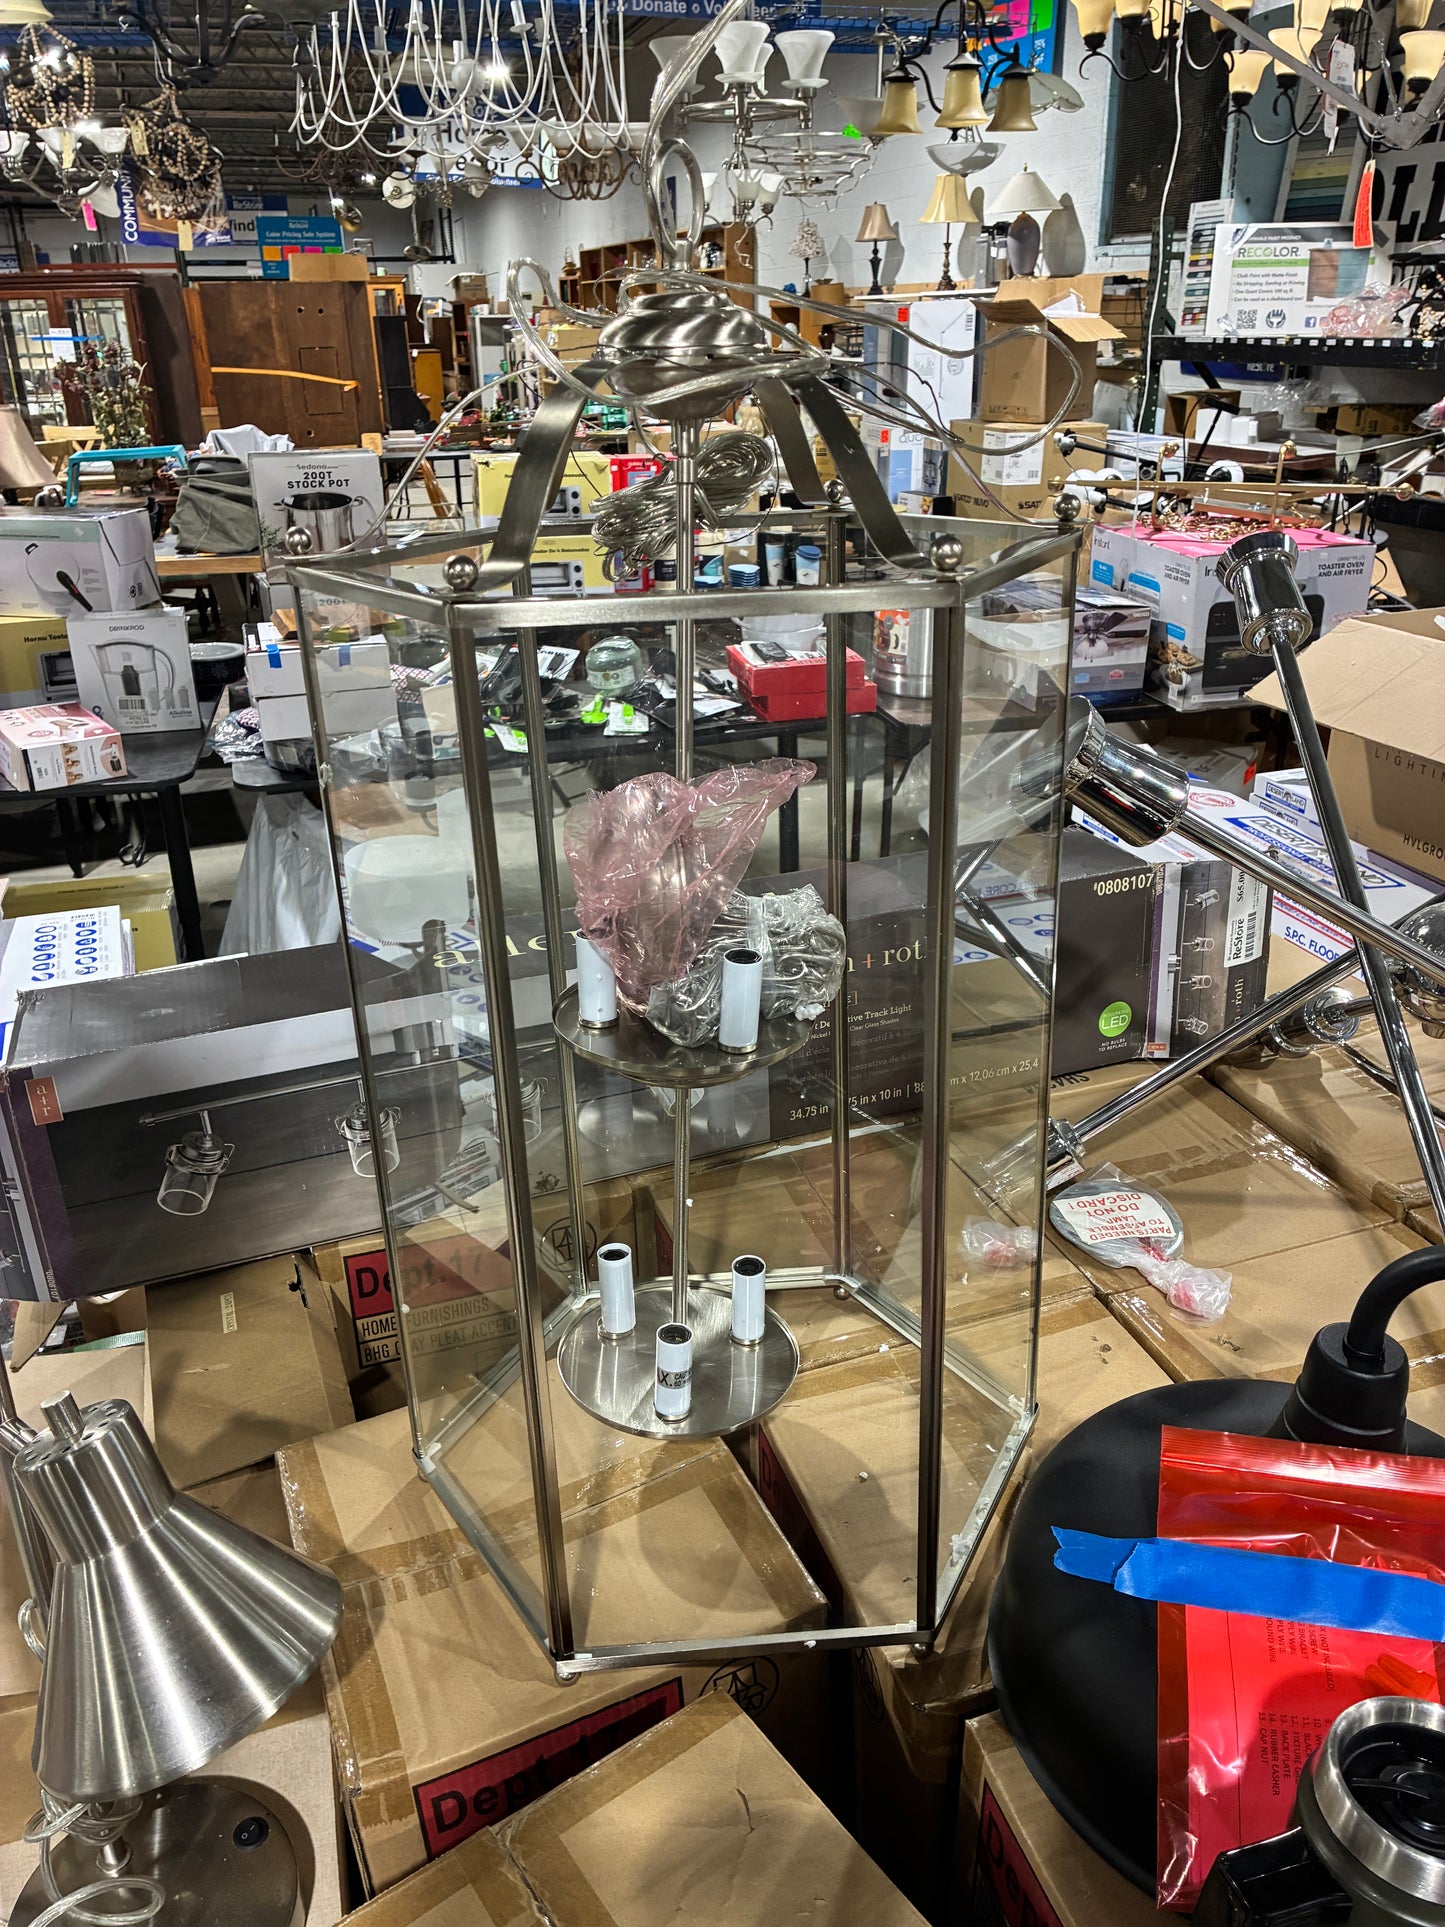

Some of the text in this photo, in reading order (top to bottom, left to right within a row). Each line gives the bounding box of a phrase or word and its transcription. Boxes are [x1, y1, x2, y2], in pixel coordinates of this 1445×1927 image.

[632, 0, 687, 14] Donate
[1238, 246, 1300, 258] RECOLOR
[287, 479, 351, 489] STOCK POT
[1318, 561, 1365, 571] TOASTER OVEN
[1332, 569, 1343, 577] AIR
[1344, 568, 1364, 576] FRYER
[1251, 820, 1315, 847] DESERT
[1403, 833, 1445, 859] HVLGRO
[1233, 918, 1245, 960] ReStore
[1284, 926, 1307, 947] S.P.C.
[882, 937, 927, 967] rot
[864, 1003, 912, 1020] Track Light
[849, 1024, 864, 1032] Clear
[1101, 1014, 1128, 1030] LED
[1106, 1042, 1128, 1051] REPLACE
[969, 1066, 995, 1082] 12,06
[997, 1067, 1010, 1078] cm
[1019, 1057, 1039, 1073] 25,4
[860, 1094, 869, 1105] in
[879, 1088, 891, 1101] 10
[892, 1087, 902, 1097] in
[790, 1103, 829, 1121] 34.75 in
[1076, 1192, 1142, 1209] DISCARD
[1086, 1202, 1140, 1218] DO NOT
[1148, 1217, 1166, 1225] TO
[1089, 1226, 1172, 1241] PARTS NEEDED
[361, 1297, 490, 1338] HOME FURNISHINGS
[364, 1342, 388, 1363] BHG
[429, 1327, 468, 1348] PLEAT
[1261, 1728, 1269, 1746] CAP
[1270, 1729, 1279, 1762] RUBBER
[1281, 1730, 1289, 1752] BACK
[1283, 1753, 1292, 1779] PLATE
[1272, 1763, 1280, 1796] EASHER
